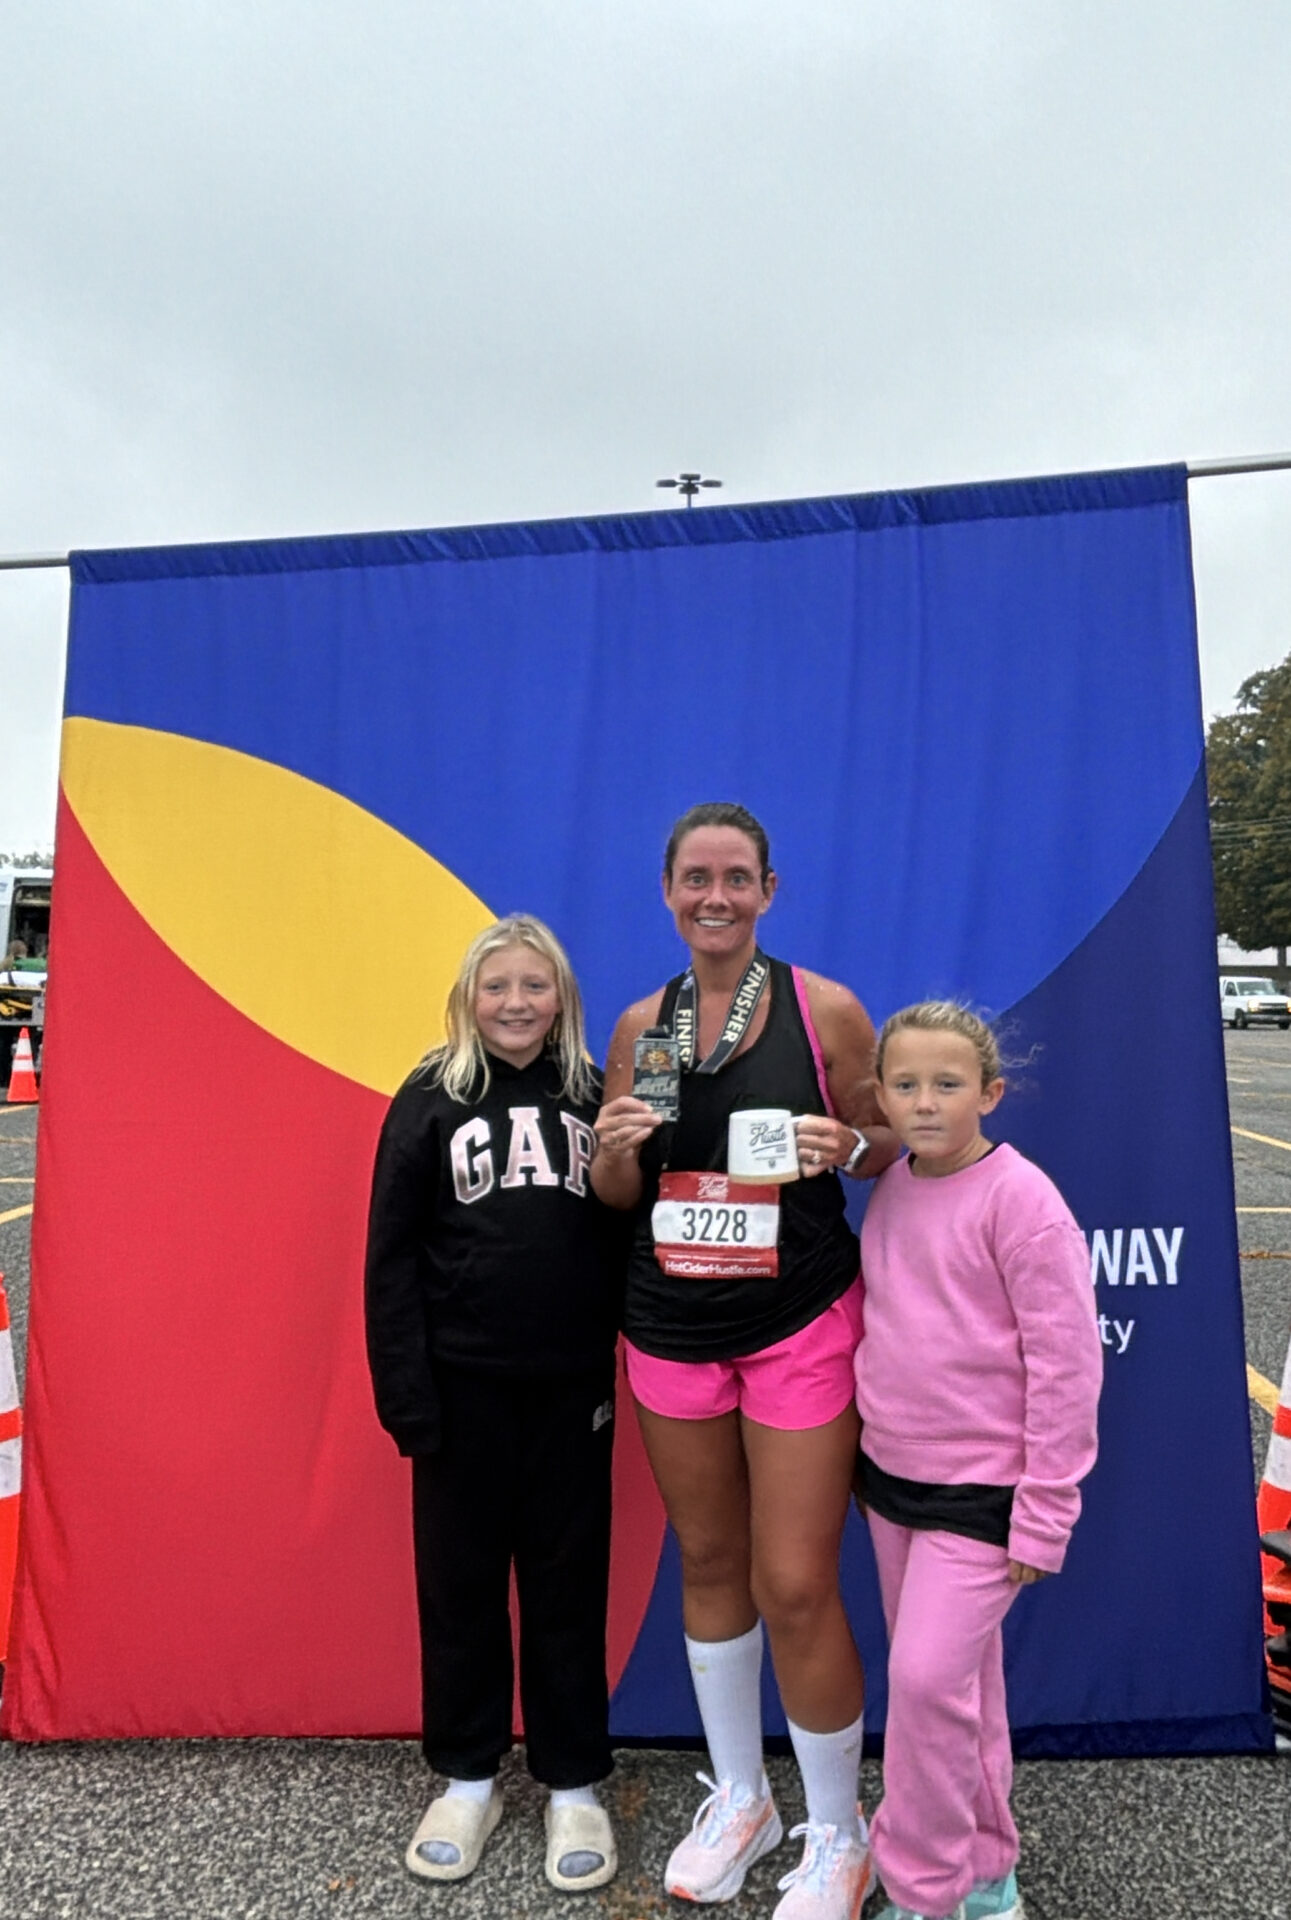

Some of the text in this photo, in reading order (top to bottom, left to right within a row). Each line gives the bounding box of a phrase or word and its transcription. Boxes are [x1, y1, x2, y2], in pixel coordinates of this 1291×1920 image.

[722, 961, 766, 1043] FINISHER
[677, 1008, 693, 1062] FINIS
[450, 1106, 598, 1205] GAP
[682, 1207, 747, 1242] 3228
[665, 1260, 771, 1275] HotCiderHustle.com
